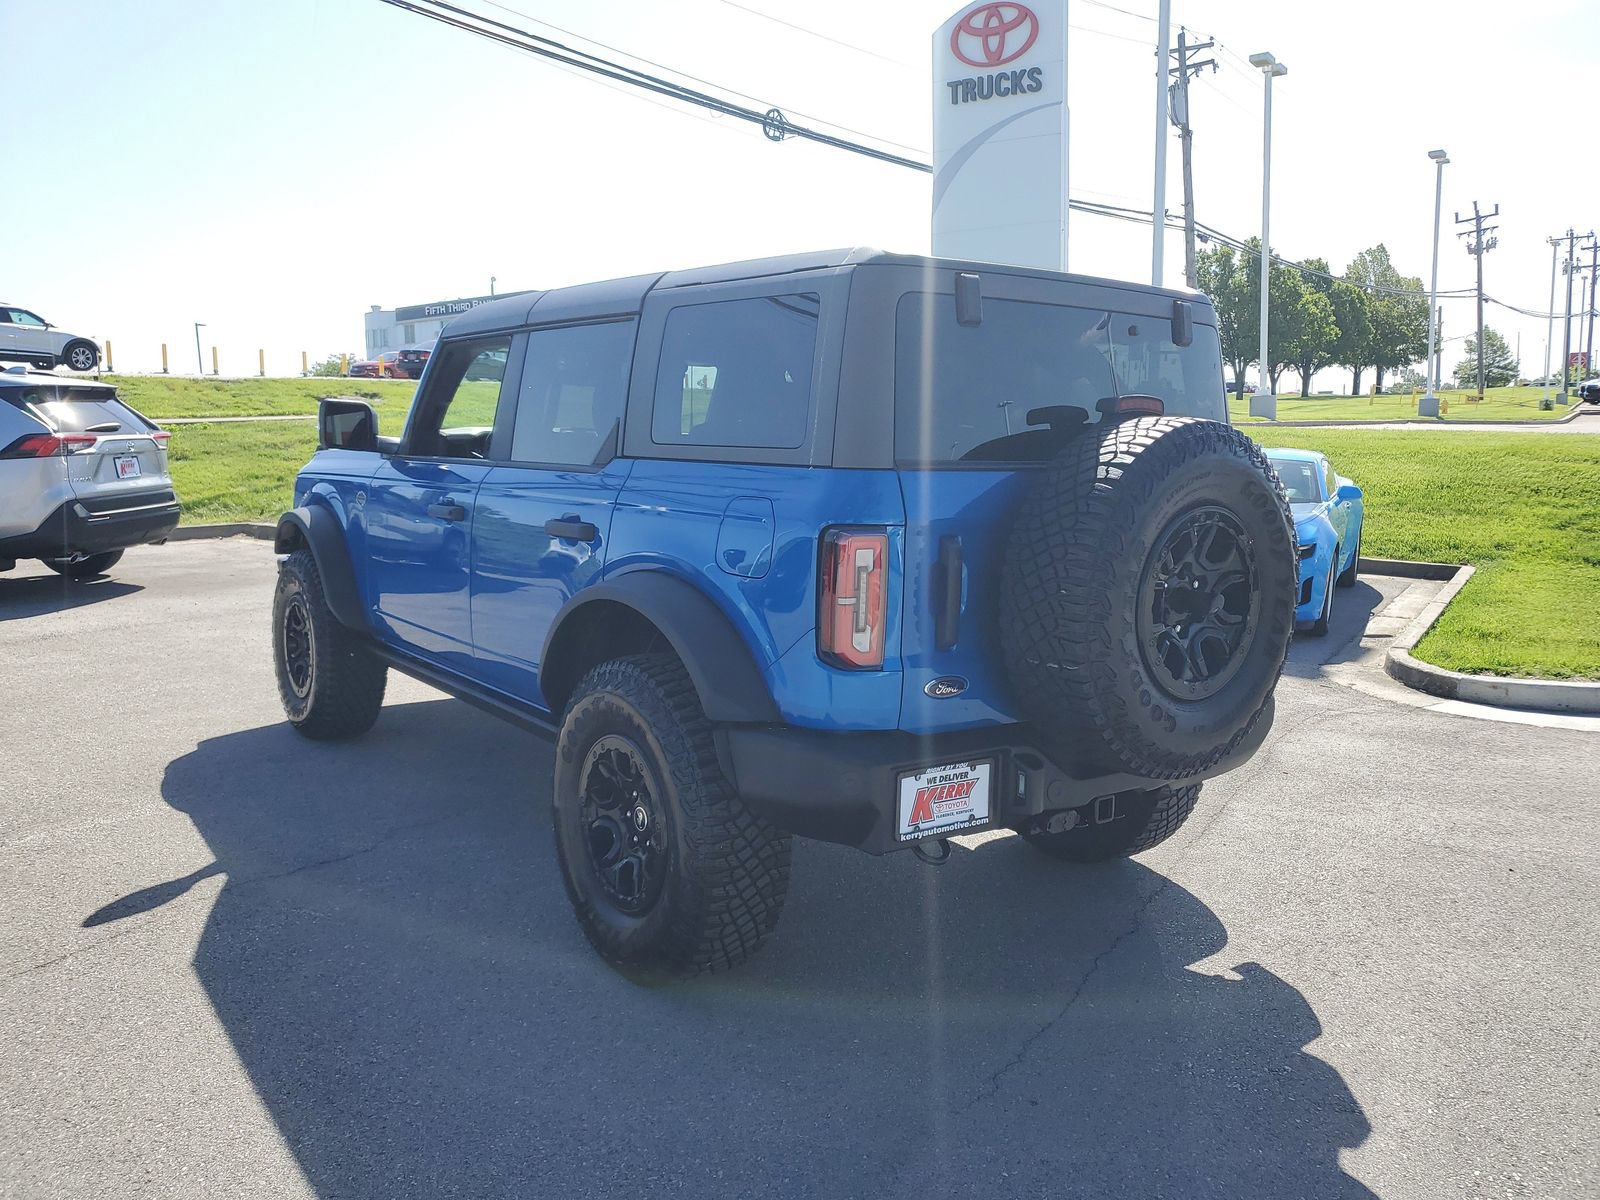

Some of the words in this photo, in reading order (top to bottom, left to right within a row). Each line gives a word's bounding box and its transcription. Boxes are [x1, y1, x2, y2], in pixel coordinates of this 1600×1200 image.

[946, 66, 1043, 105] TRUCKS
[425, 306, 446, 316] FIFTH
[448, 302, 471, 313] THIRD
[935, 681, 959, 695] Ford
[926, 776, 938, 786] WE
[938, 771, 969, 784] DELIVER
[908, 778, 979, 826] KERRY
[944, 800, 968, 810] TOYOTA
[900, 817, 990, 842] kerryautomotive.com
